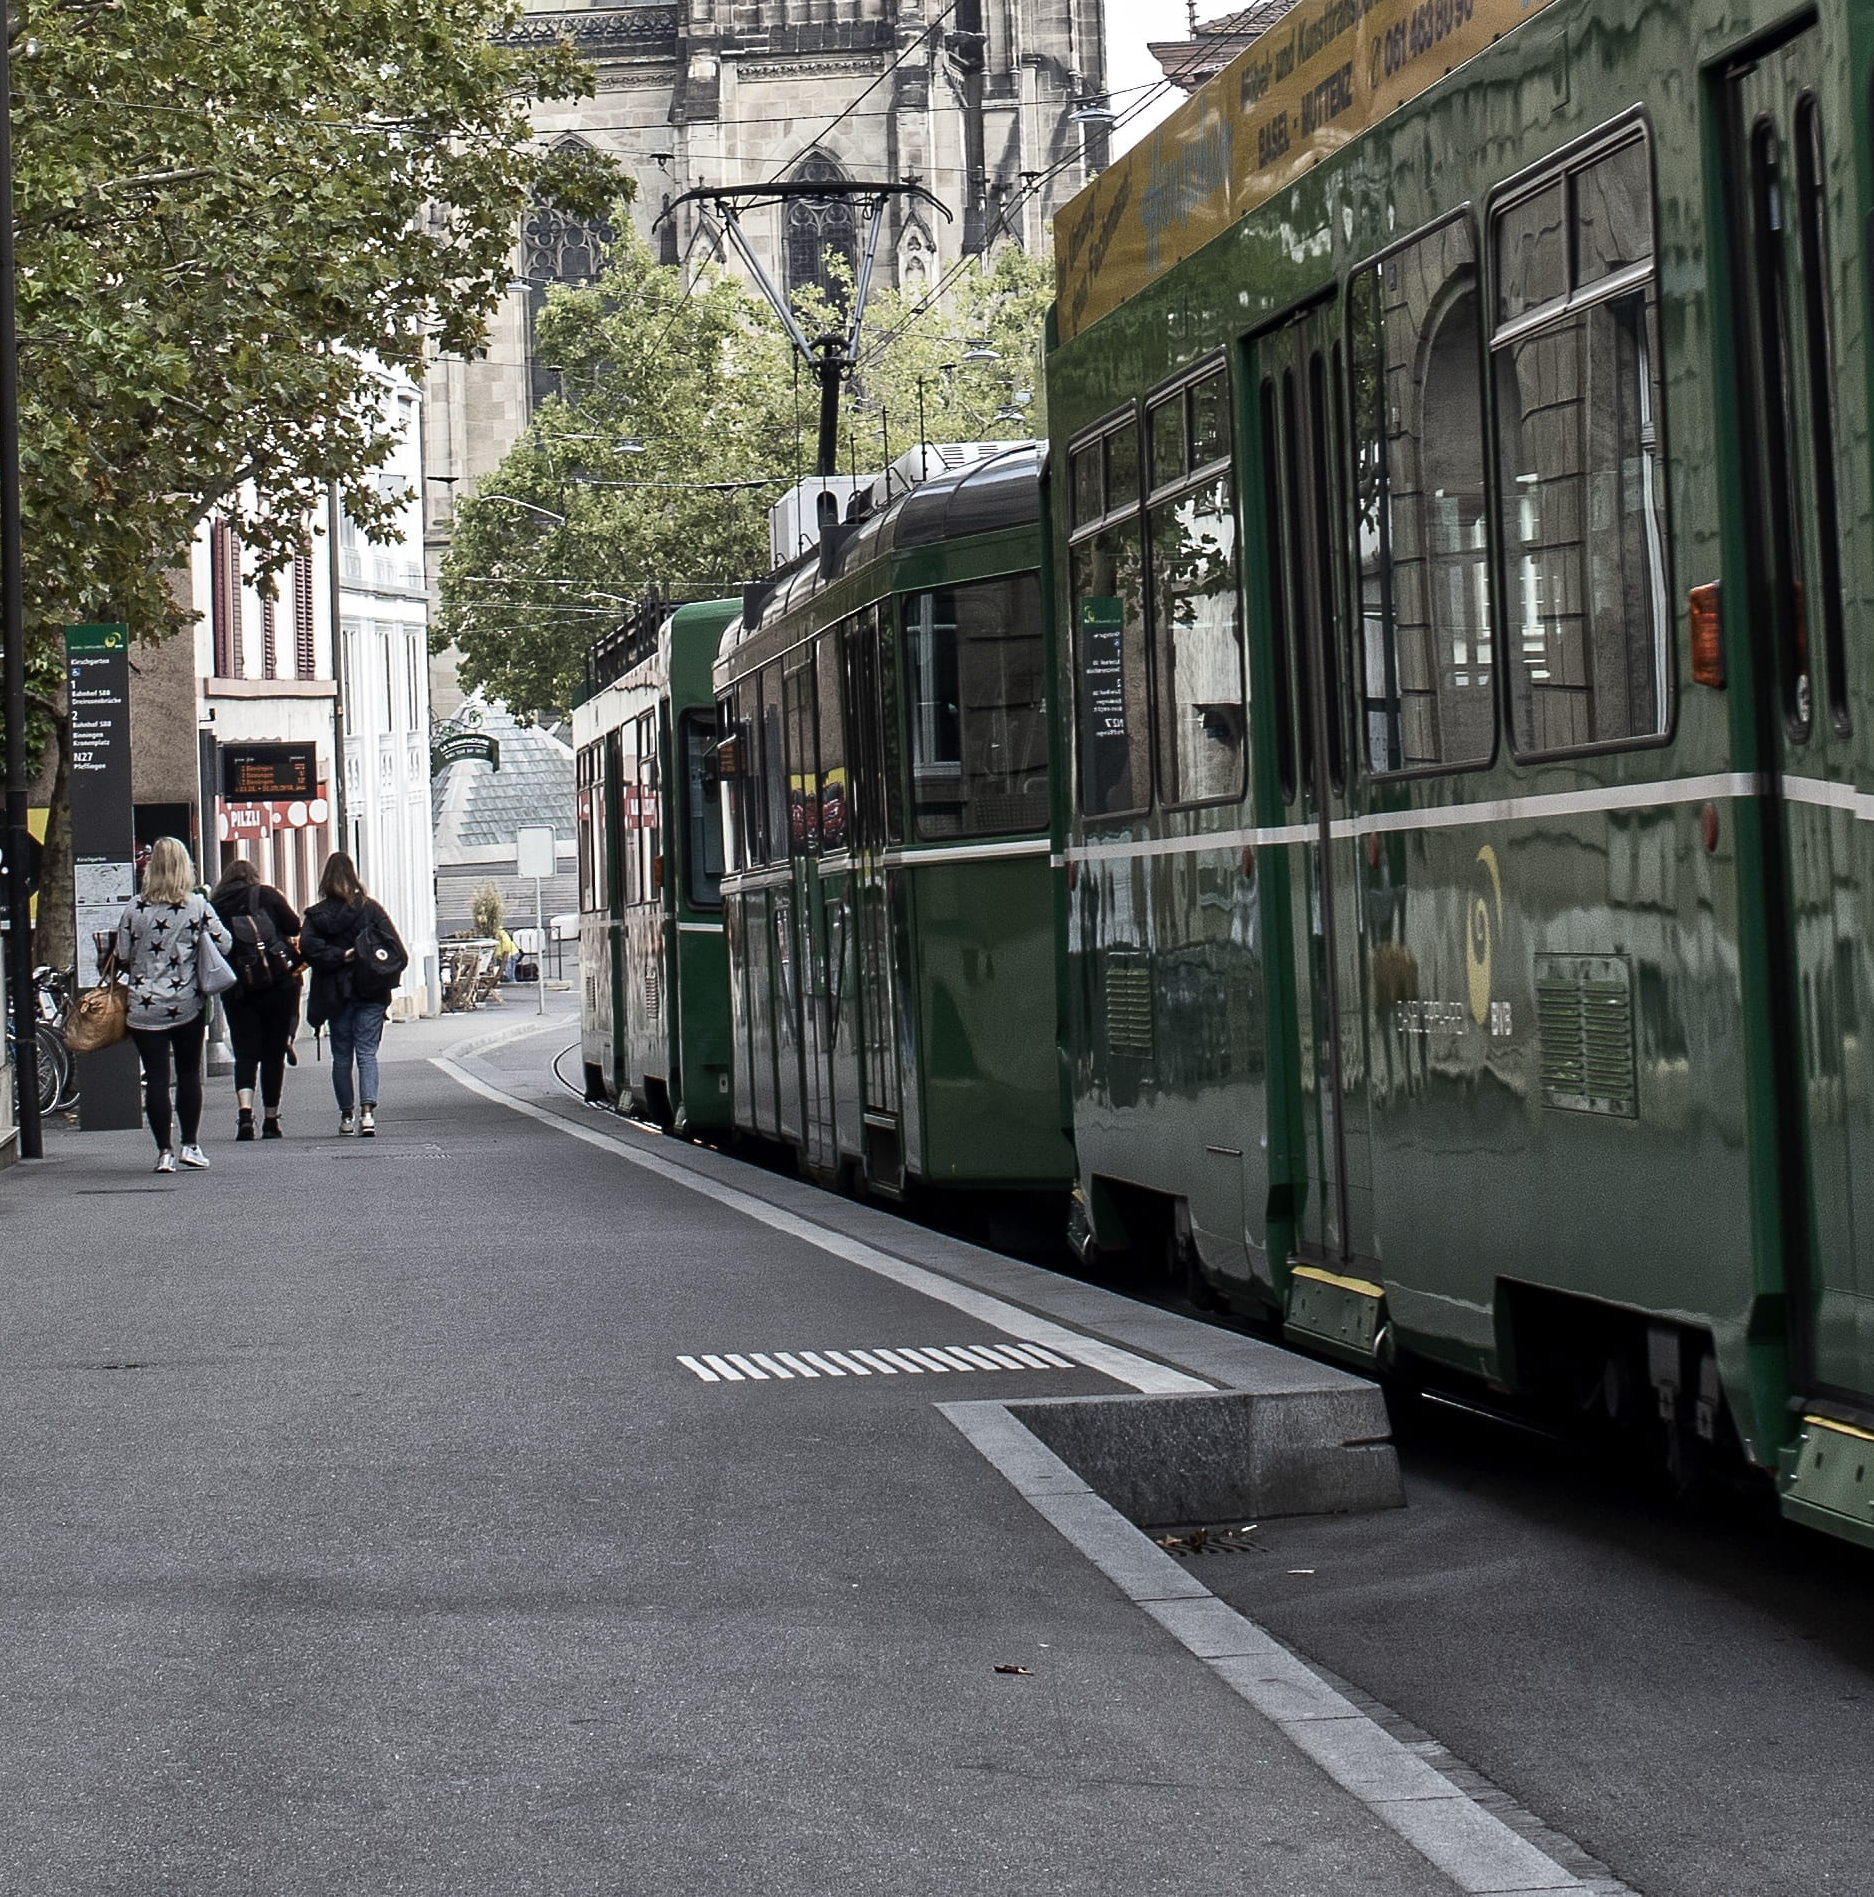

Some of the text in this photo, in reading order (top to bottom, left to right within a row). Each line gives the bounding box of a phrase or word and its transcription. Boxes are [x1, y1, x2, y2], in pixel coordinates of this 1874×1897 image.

[1258, 111, 1291, 169] BASEL
[1301, 61, 1353, 138] MUTTENZ
[70, 680, 76, 689] 1
[71, 710, 78, 720] 2
[73, 752, 93, 761] N27
[231, 810, 261, 827] PILZLI
